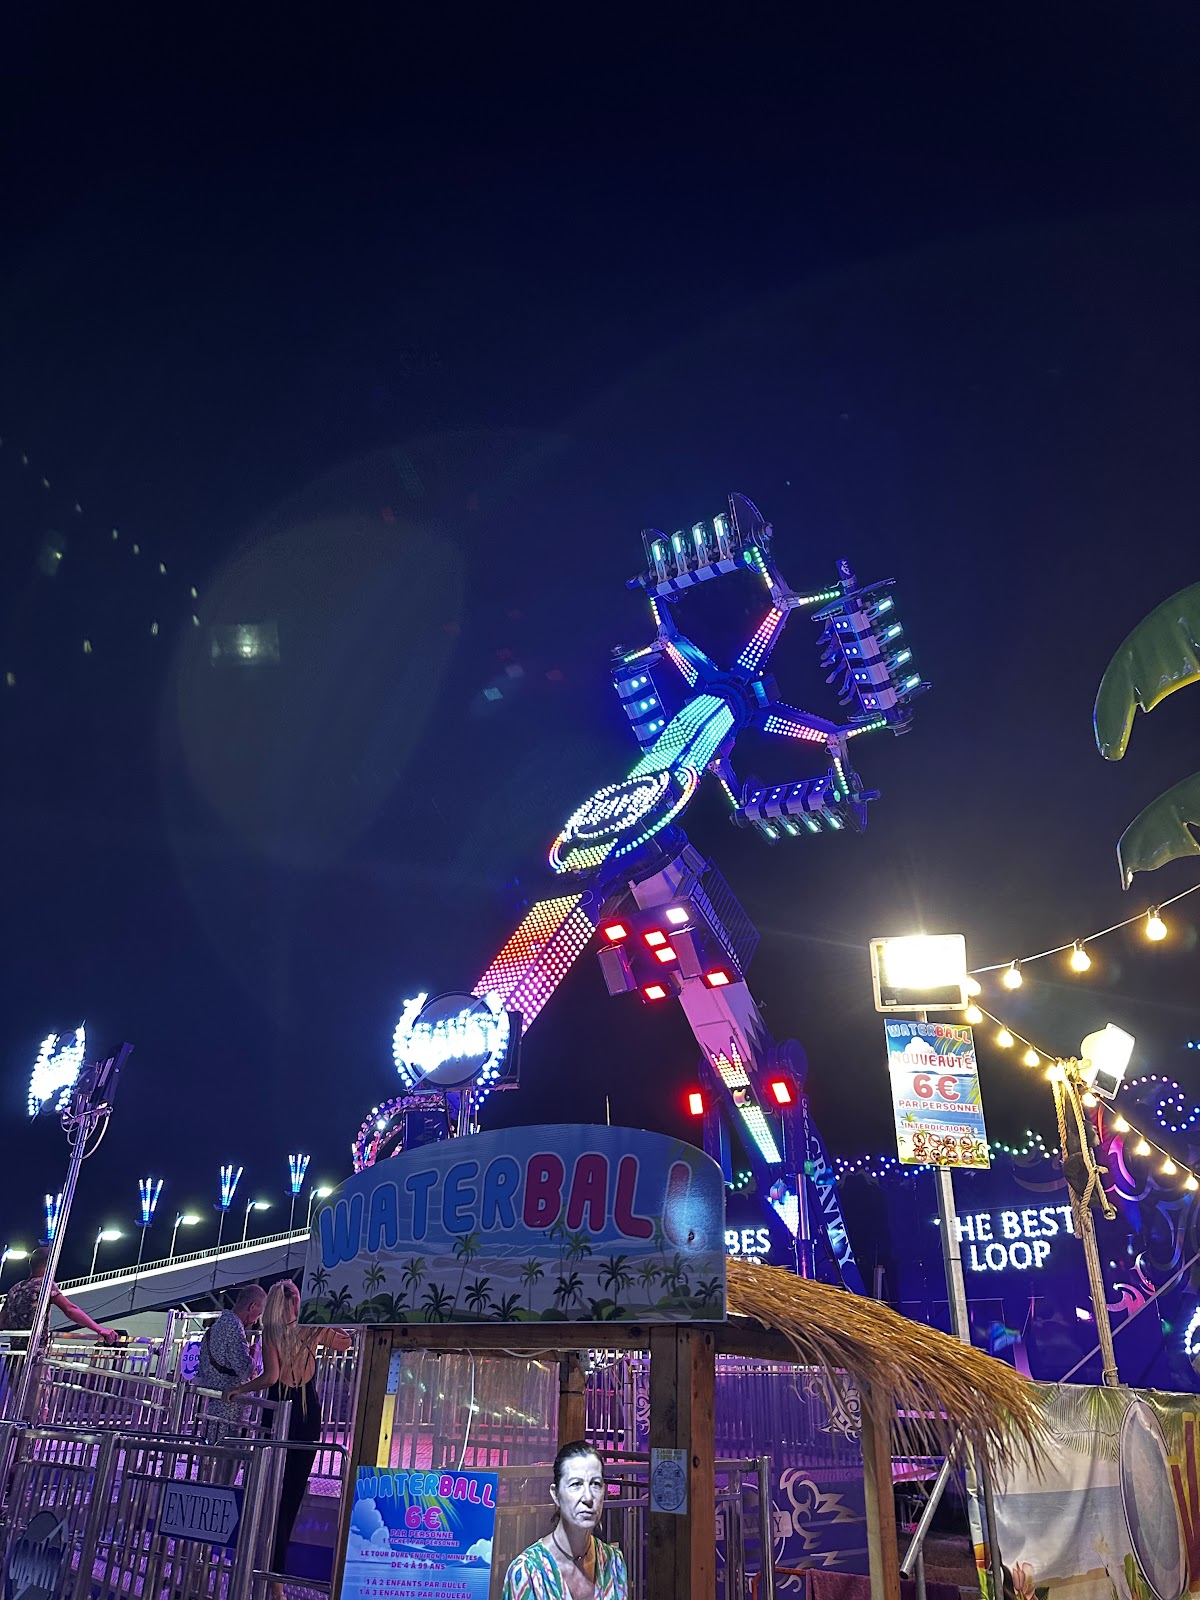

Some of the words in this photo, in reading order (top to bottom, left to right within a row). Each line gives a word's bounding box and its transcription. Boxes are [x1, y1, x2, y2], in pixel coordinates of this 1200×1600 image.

[888, 1023, 971, 1044] WATERBALL
[913, 1074, 961, 1101] 6€
[898, 1099, 919, 1109] PAR
[922, 1102, 979, 1113] PERSONNE
[904, 1122, 971, 1133] INTERDICTIONS
[933, 1213, 993, 1242] HE
[1001, 1205, 1075, 1239] BEST
[725, 1228, 772, 1254] BES
[970, 1240, 1051, 1271] LOOP
[357, 1473, 495, 1508] WATERBALL
[164, 1492, 232, 1534] ENTREE
[405, 1505, 443, 1529] 6€
[390, 1529, 407, 1538] PAR
[409, 1530, 454, 1539] PERSONNE
[391, 1561, 402, 1569] DE
[418, 1562, 429, 1570] 99
[410, 1553, 441, 1561] ENVIRON
[372, 1577, 378, 1585] À
[386, 1579, 422, 1587] ENFANTS
[424, 1580, 440, 1588] PAR
[379, 1590, 416, 1598] ENFANTS
[435, 1591, 472, 1599] ROULEAU
